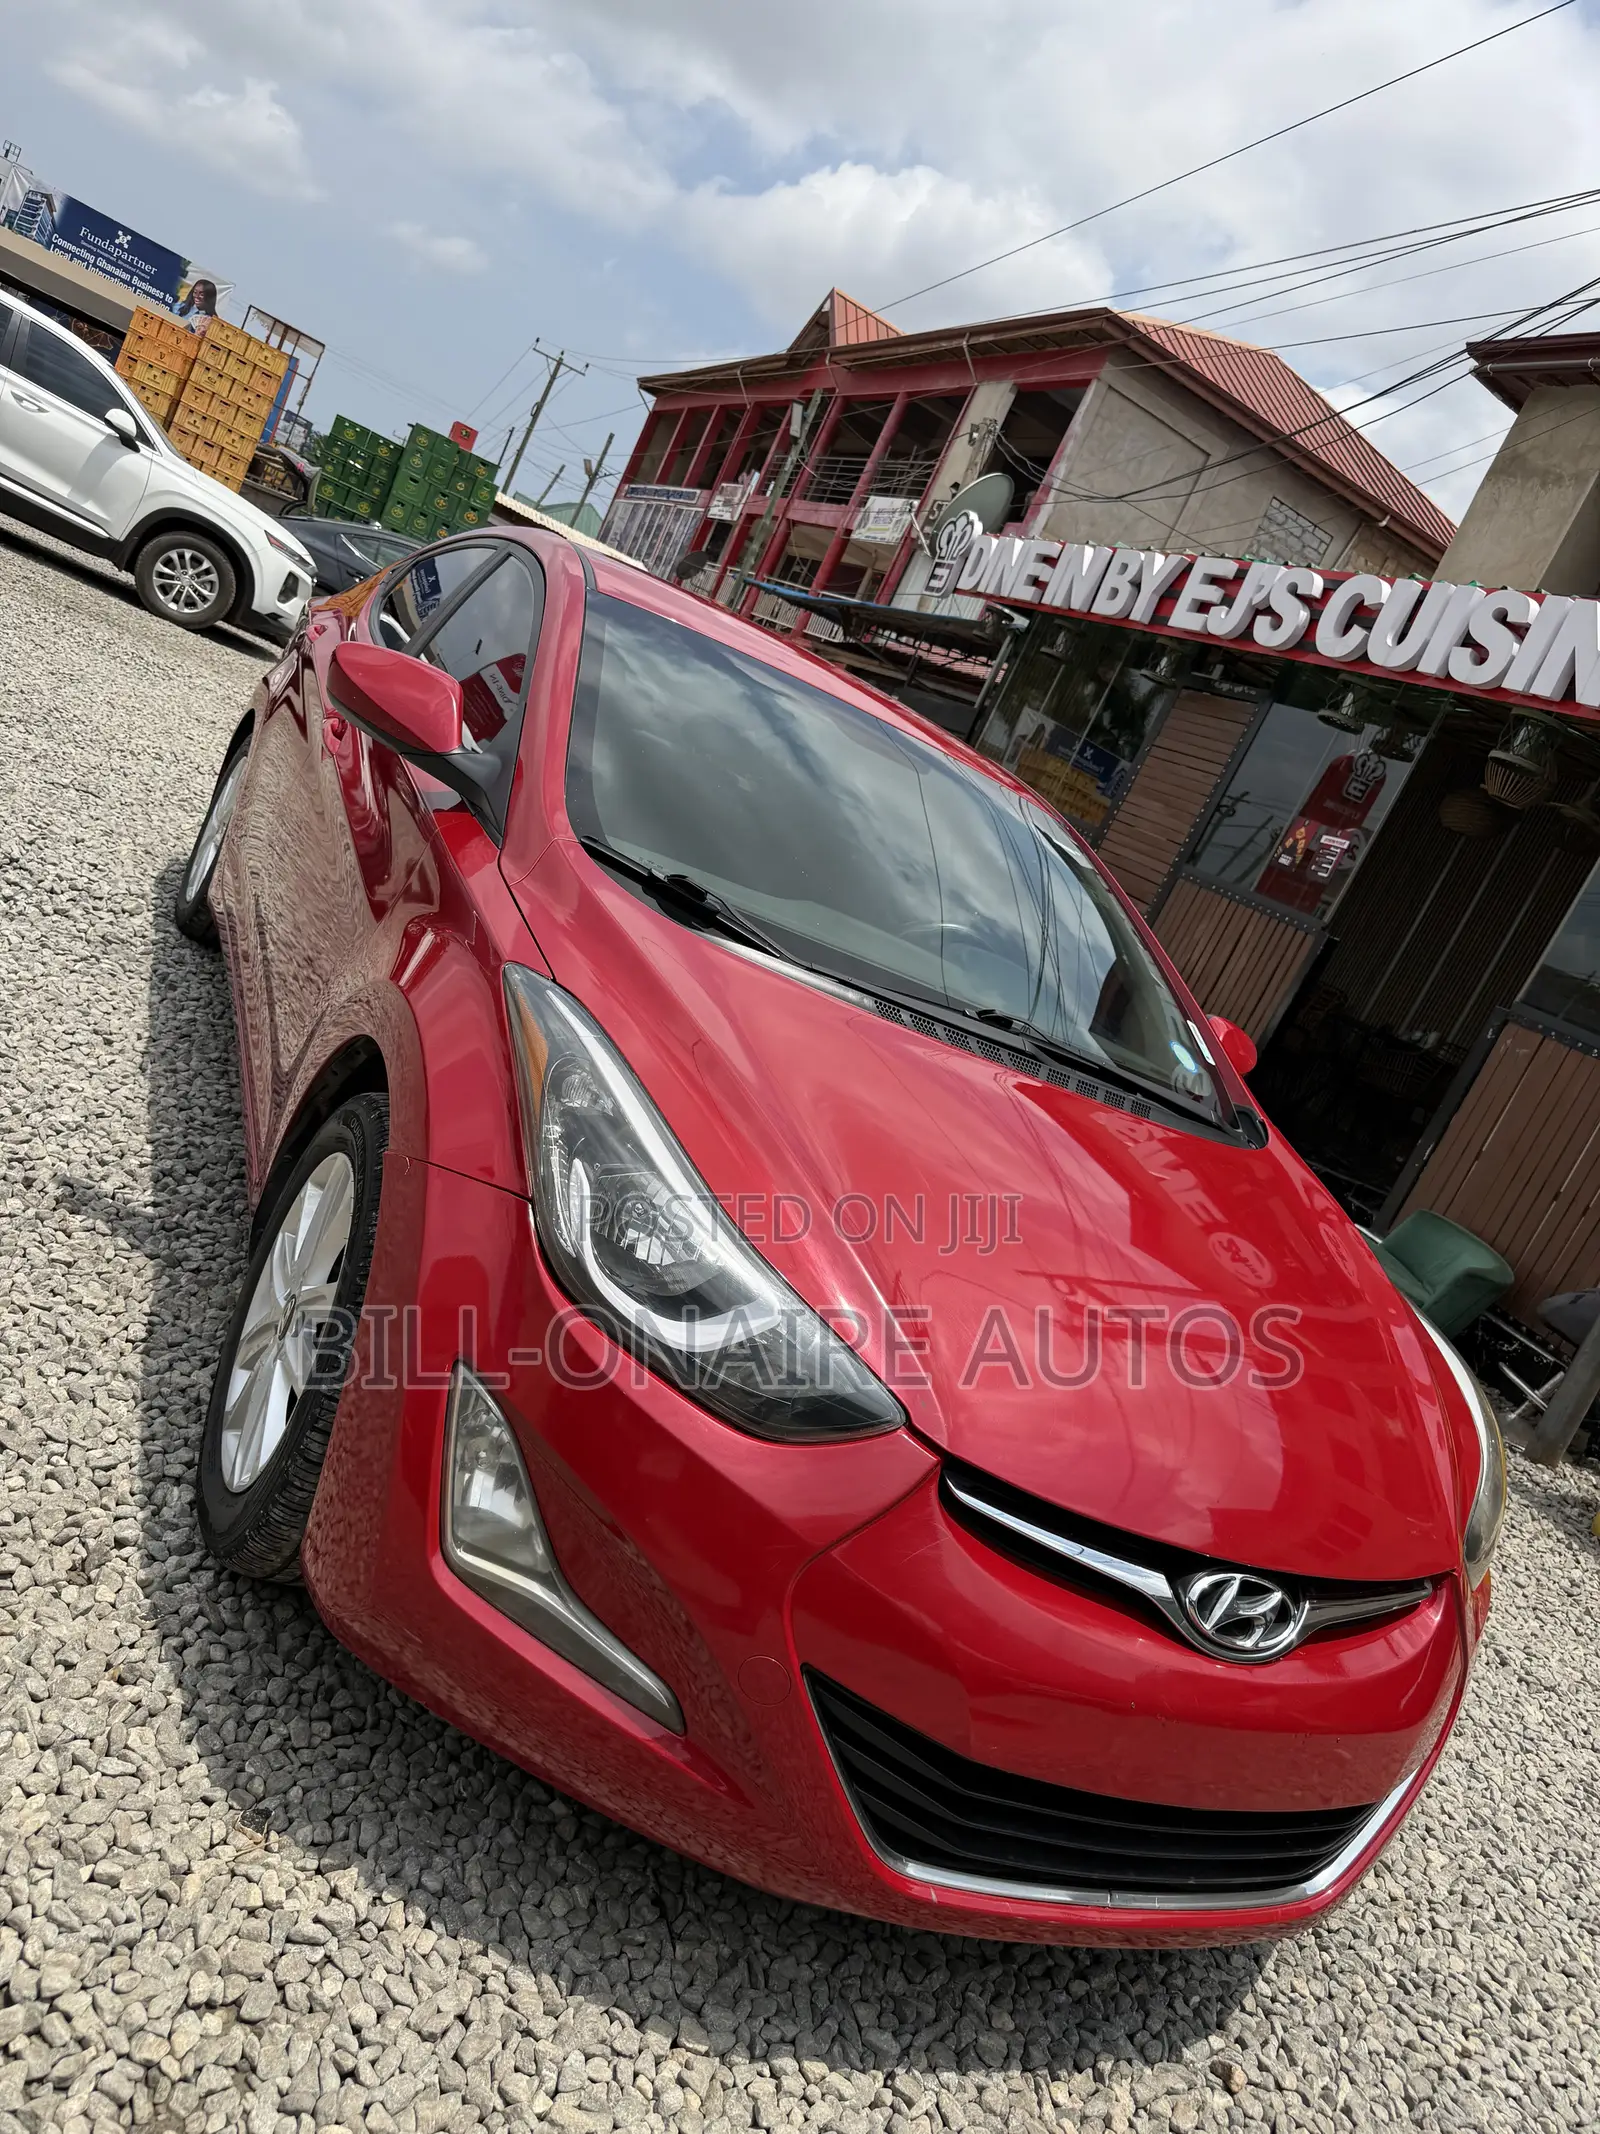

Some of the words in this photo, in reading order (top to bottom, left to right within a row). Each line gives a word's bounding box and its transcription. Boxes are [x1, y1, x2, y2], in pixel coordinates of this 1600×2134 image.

[50, 244, 72, 261] Local
[72, 256, 88, 269] and
[52, 233, 95, 263] Connecting
[97, 258, 130, 281] Ghanaian
[132, 276, 164, 299] Business
[165, 292, 173, 304] to
[79, 226, 157, 275] Fundapartner
[956, 534, 1063, 604] DINE
[1091, 548, 1189, 624] BY
[1168, 558, 1323, 651] EJ'S
